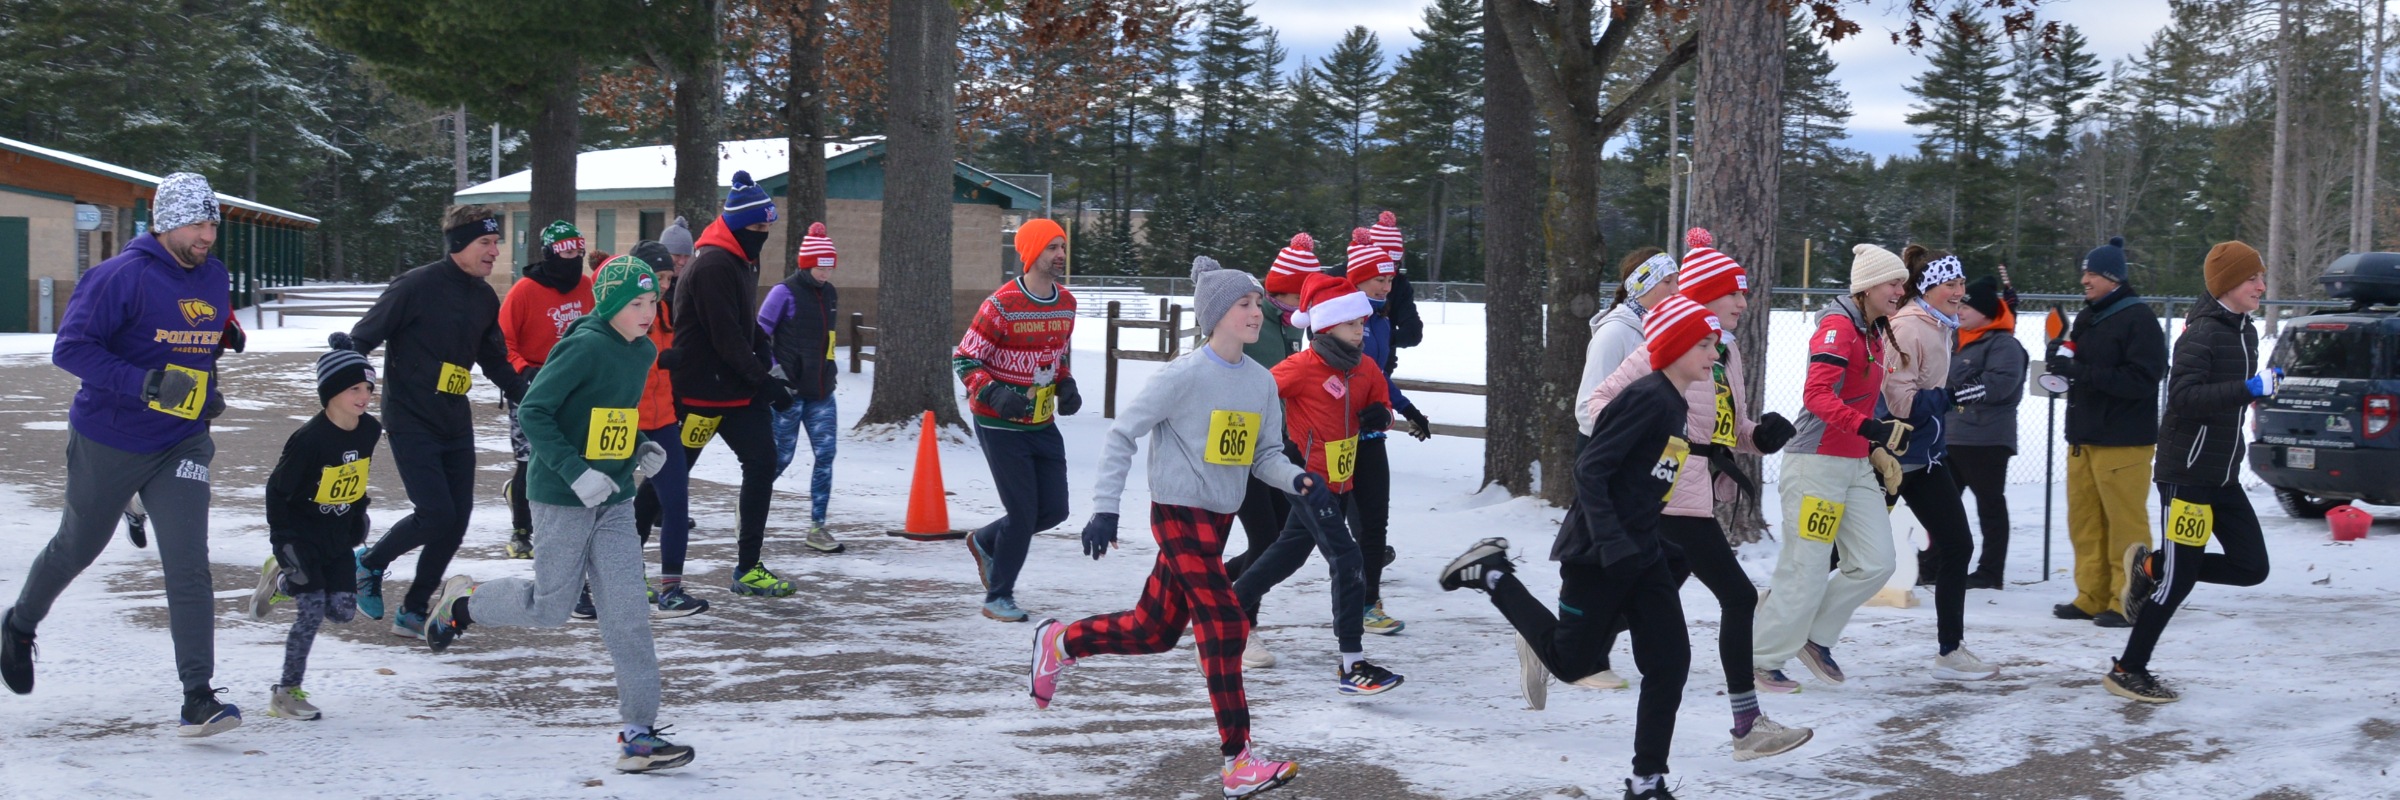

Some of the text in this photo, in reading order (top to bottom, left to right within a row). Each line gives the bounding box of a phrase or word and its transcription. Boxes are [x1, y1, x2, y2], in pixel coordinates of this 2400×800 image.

[553, 240, 577, 254] RUN
[1013, 322, 1045, 333] GNOME
[1048, 321, 1062, 332] FOR
[447, 373, 467, 394] 678
[2277, 399, 2331, 407] BRONCO
[600, 425, 629, 451] 673
[1219, 429, 1248, 456] 686
[330, 474, 360, 499] 672
[1807, 511, 1837, 536] 667
[2175, 515, 2206, 539] 680
